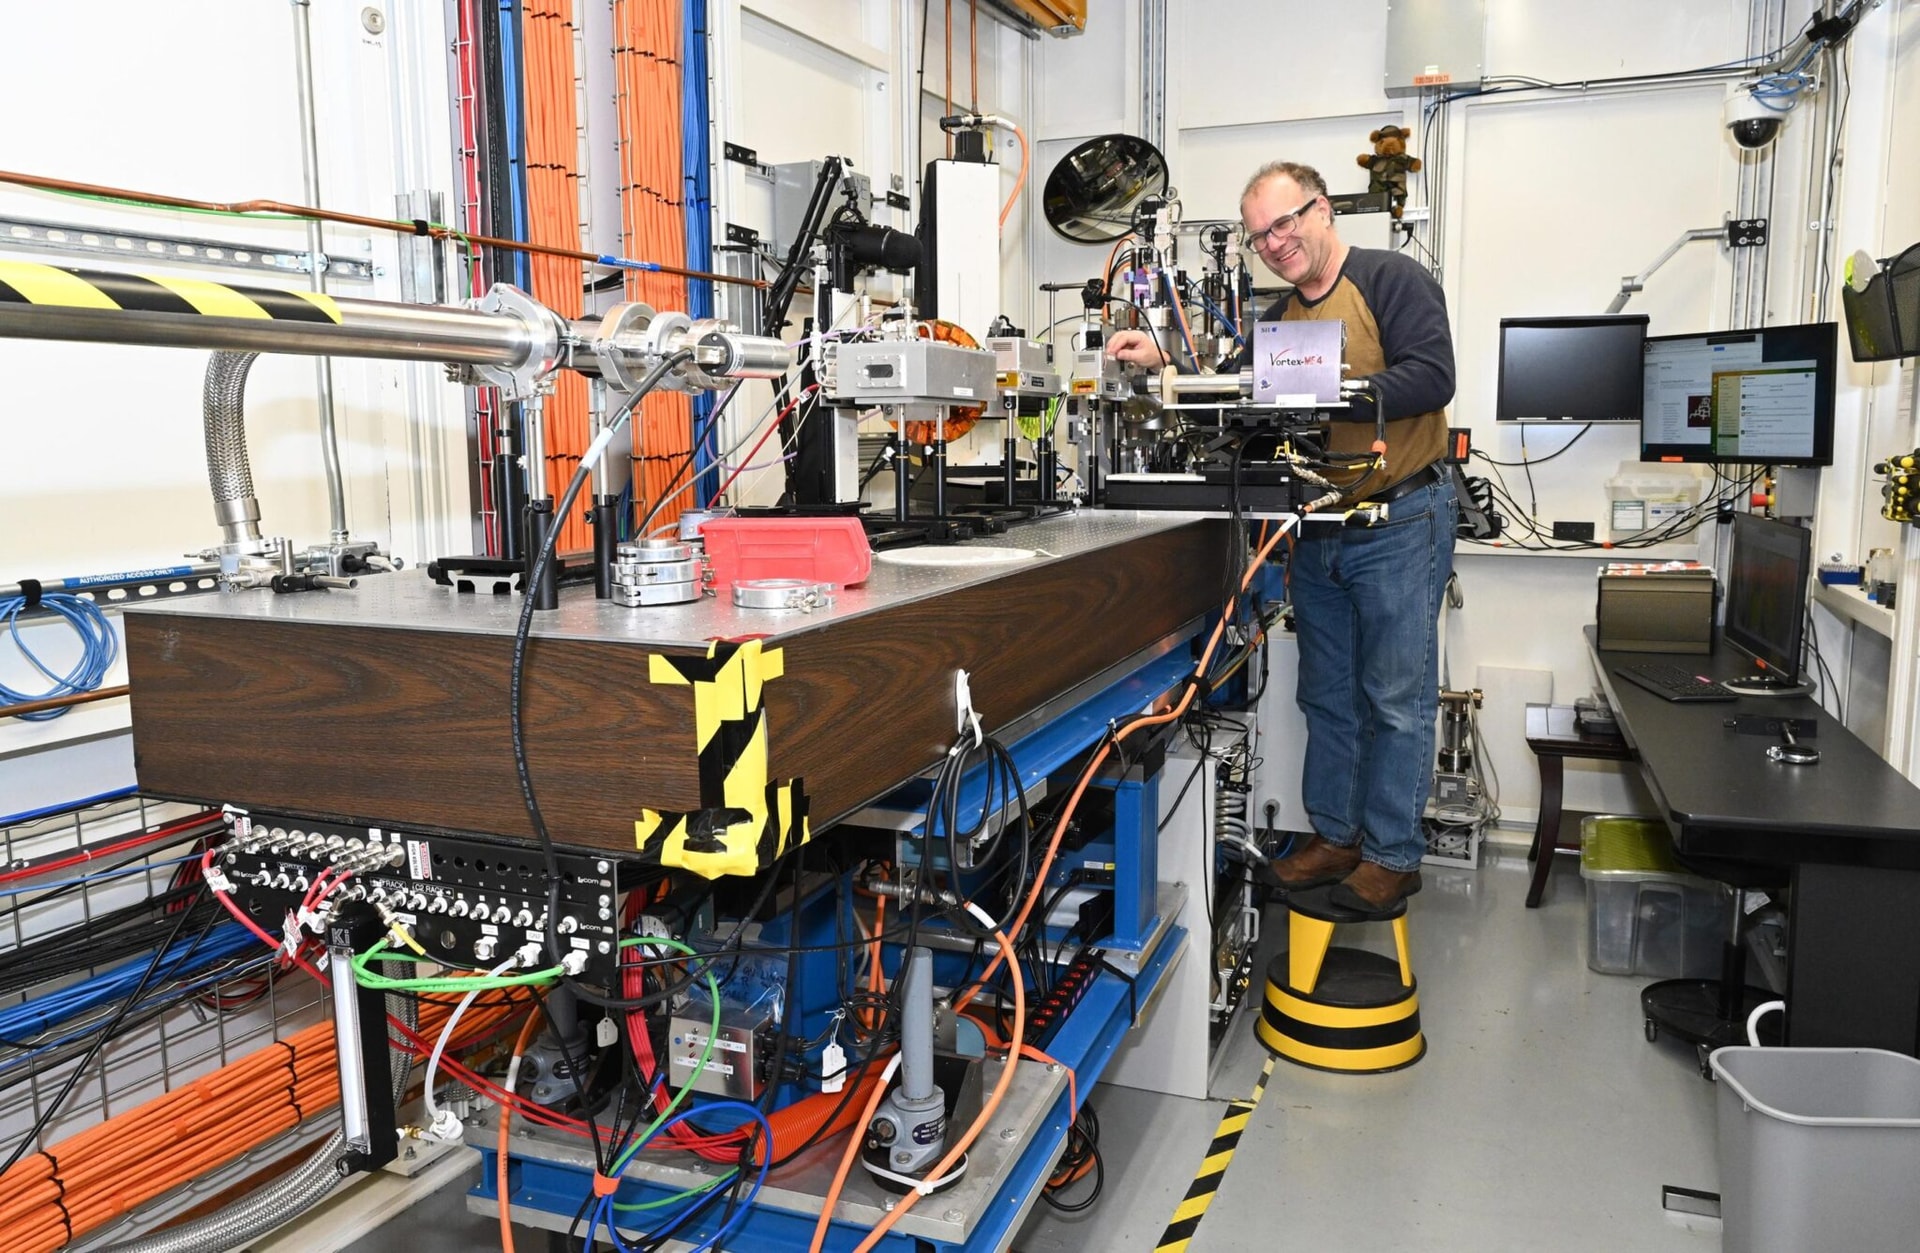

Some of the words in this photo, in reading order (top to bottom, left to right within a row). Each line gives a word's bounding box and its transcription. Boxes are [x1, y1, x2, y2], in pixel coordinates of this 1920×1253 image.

[80, 573, 125, 585] AUTHORIZED
[126, 570, 154, 580] ACCESS
[155, 567, 175, 577] ONLY!
